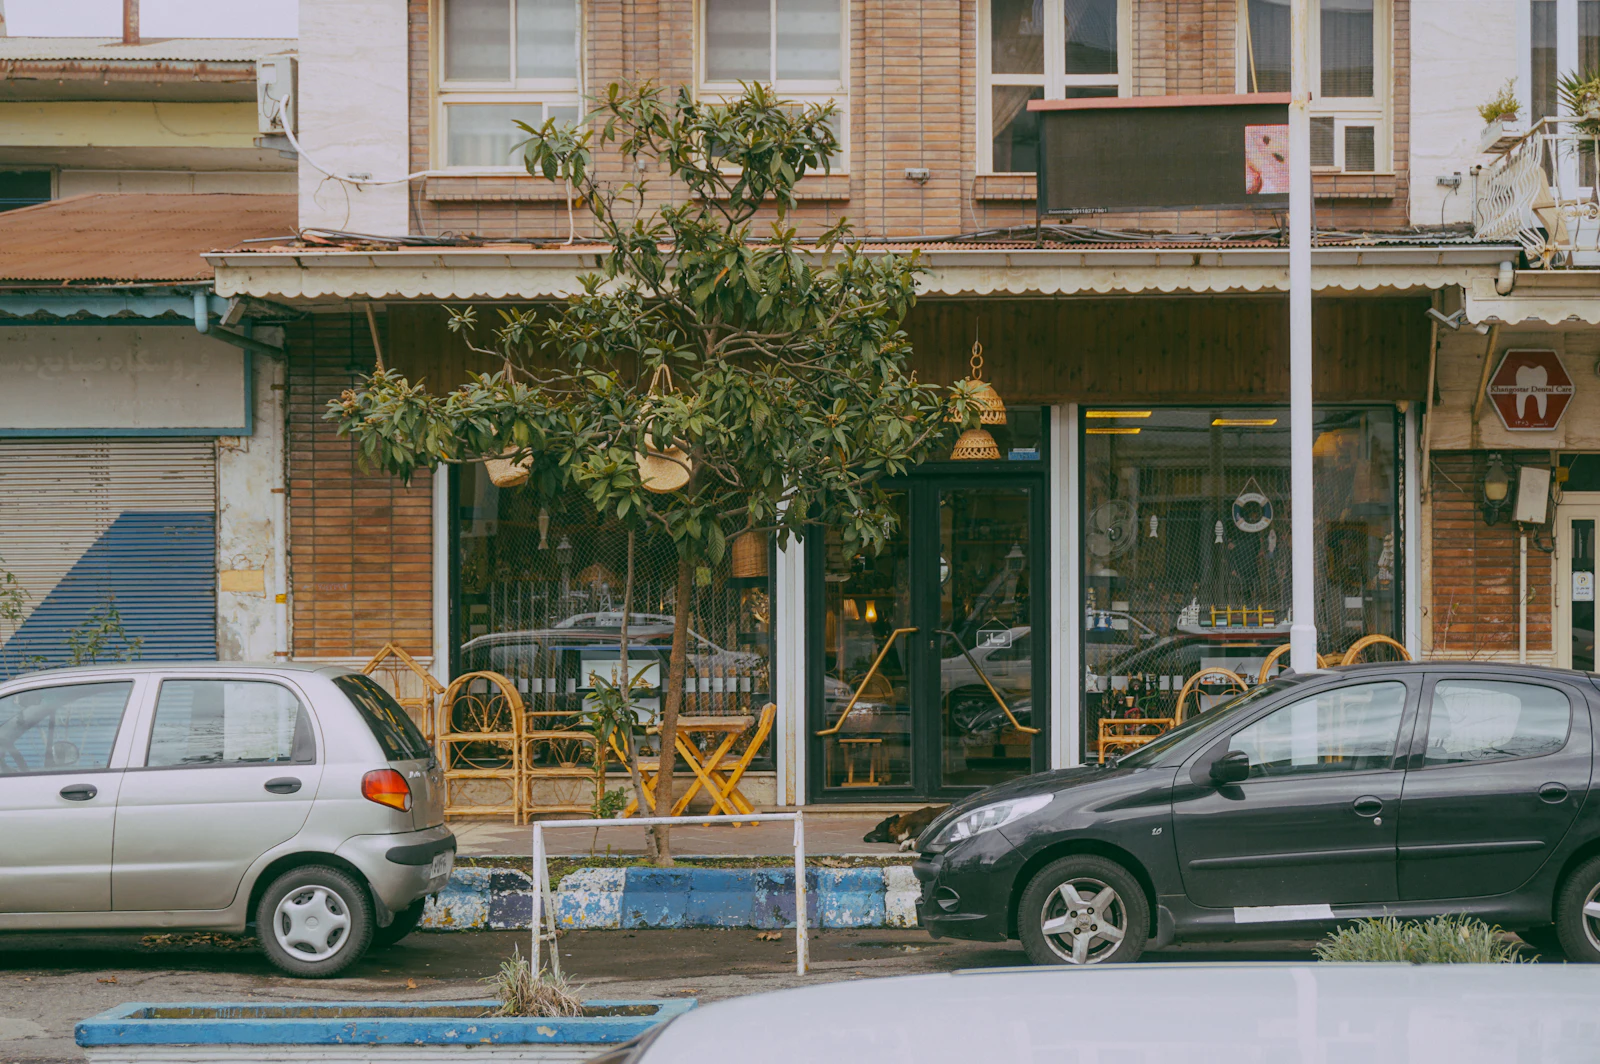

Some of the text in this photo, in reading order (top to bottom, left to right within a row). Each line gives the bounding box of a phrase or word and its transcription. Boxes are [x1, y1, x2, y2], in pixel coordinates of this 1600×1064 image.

[1490, 385, 1572, 394] Khangostar Dental Care
[984, 632, 1006, 647] باز
